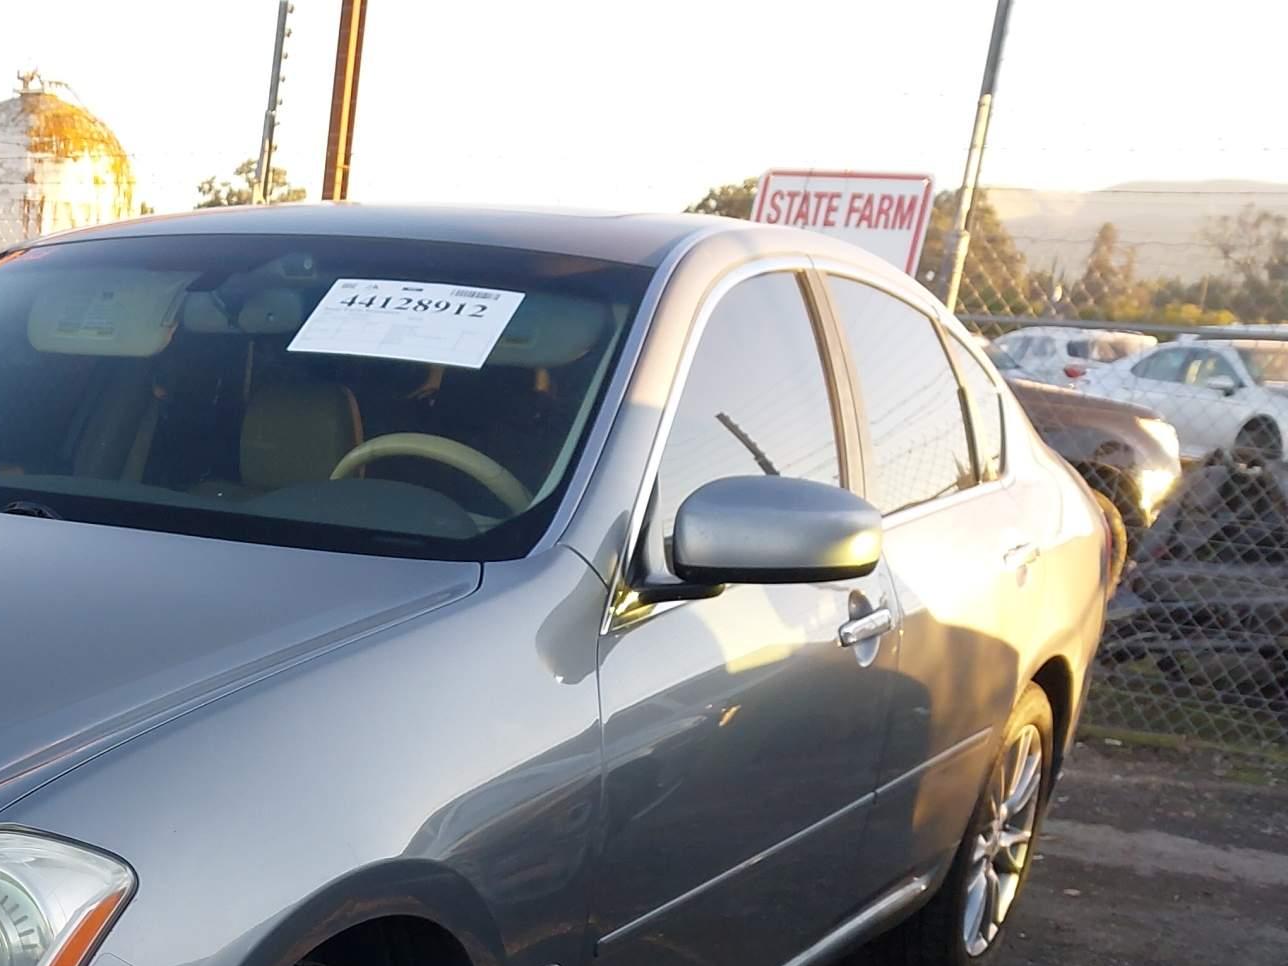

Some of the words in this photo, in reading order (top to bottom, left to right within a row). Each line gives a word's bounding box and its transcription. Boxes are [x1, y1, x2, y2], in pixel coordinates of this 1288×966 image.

[766, 189, 843, 228] STATE
[844, 193, 920, 230] FARM
[339, 293, 488, 319] 44128912
